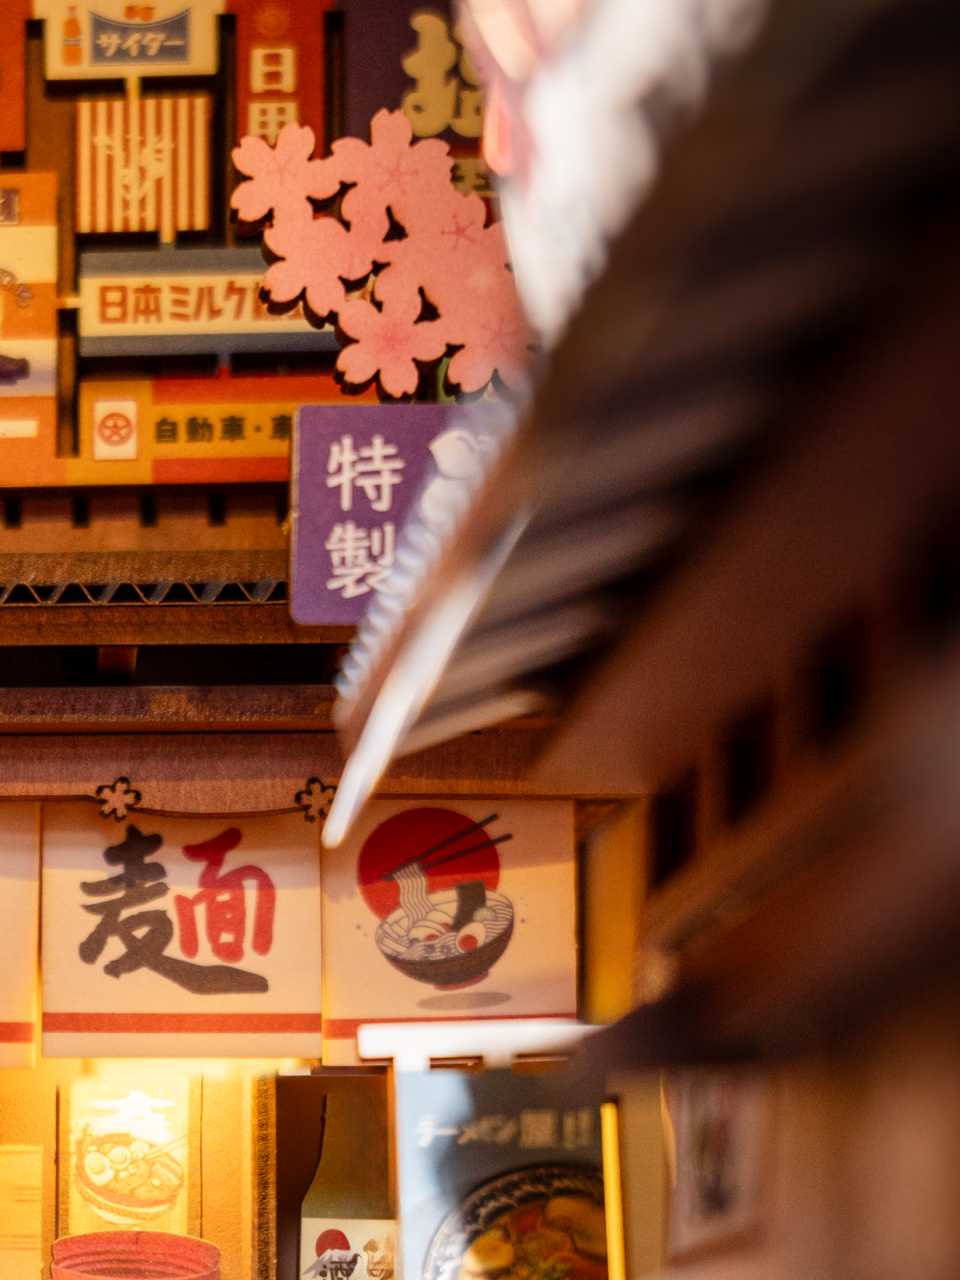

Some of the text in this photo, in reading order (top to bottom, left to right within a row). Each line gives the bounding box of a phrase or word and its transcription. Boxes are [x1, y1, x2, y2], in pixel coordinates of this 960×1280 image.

[96, 32, 186, 57] サイダー
[325, 433, 407, 599] 特製
